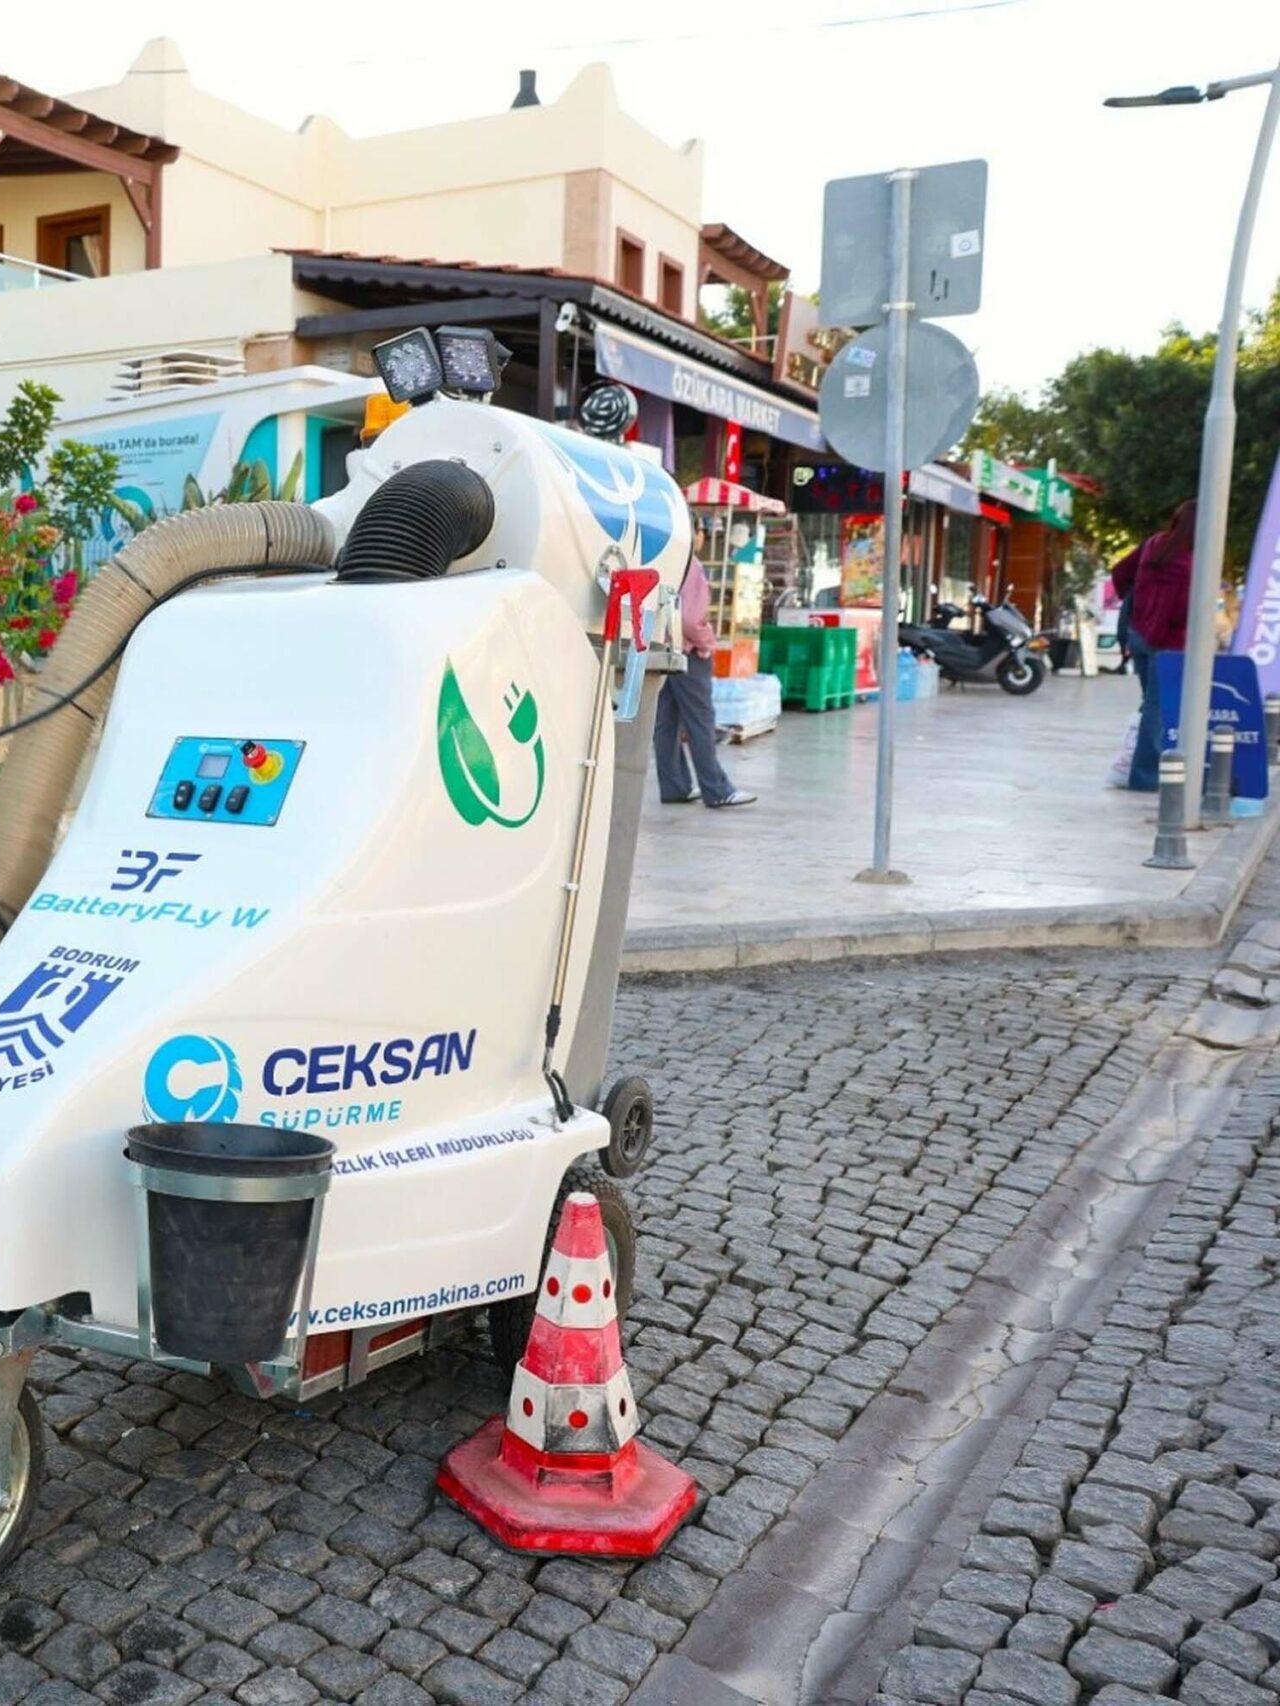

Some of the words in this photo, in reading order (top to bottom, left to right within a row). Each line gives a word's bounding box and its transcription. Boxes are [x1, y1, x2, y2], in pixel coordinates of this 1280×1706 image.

[736, 391, 781, 435] MARKET
[110, 849, 203, 893] BF
[231, 906, 270, 929] W
[49, 945, 141, 973] BODRUM
[260, 1100, 402, 1131] SÜPÜRME
[380, 1141, 436, 1168] İŞLERİ
[435, 1127, 535, 1157] MÜDÜRLÜĞÜ
